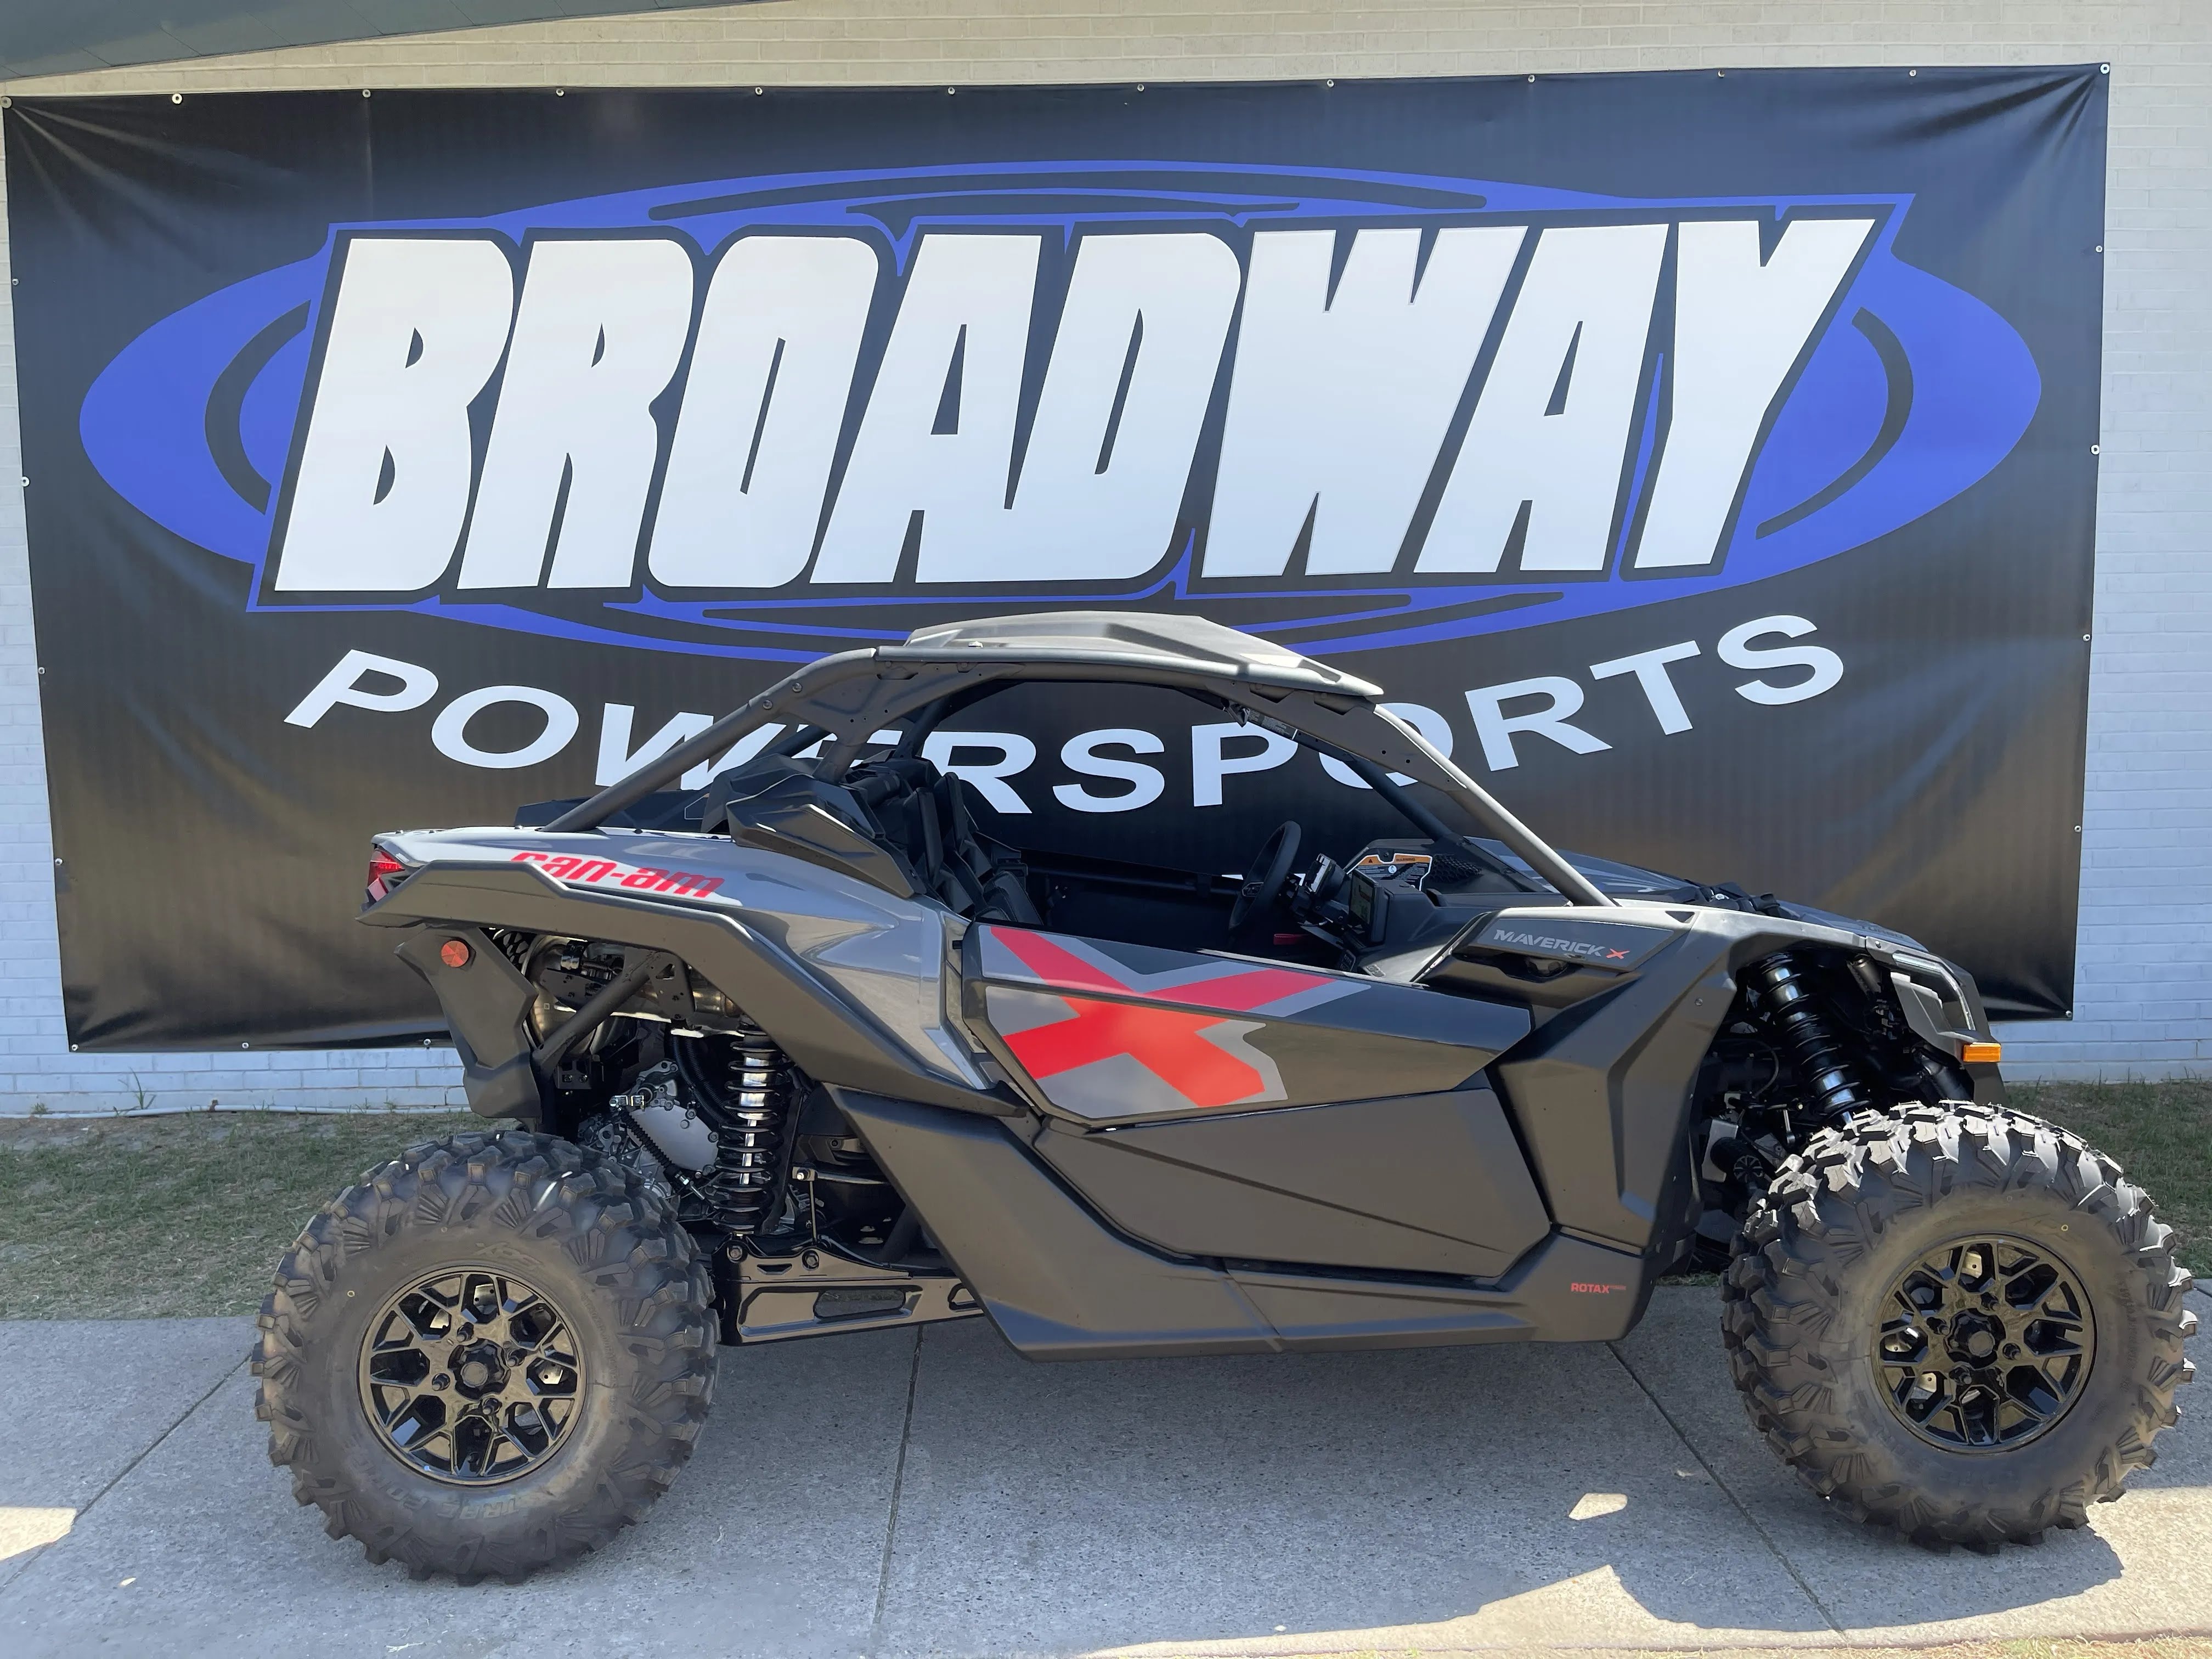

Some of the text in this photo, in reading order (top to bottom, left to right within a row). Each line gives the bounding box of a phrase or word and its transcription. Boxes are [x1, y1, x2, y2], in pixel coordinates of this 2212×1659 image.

[274, 218, 1876, 592] BROADWAY
[1493, 929, 1630, 960] MAVERICK X
[1571, 1283, 1610, 1294] ROTAX
